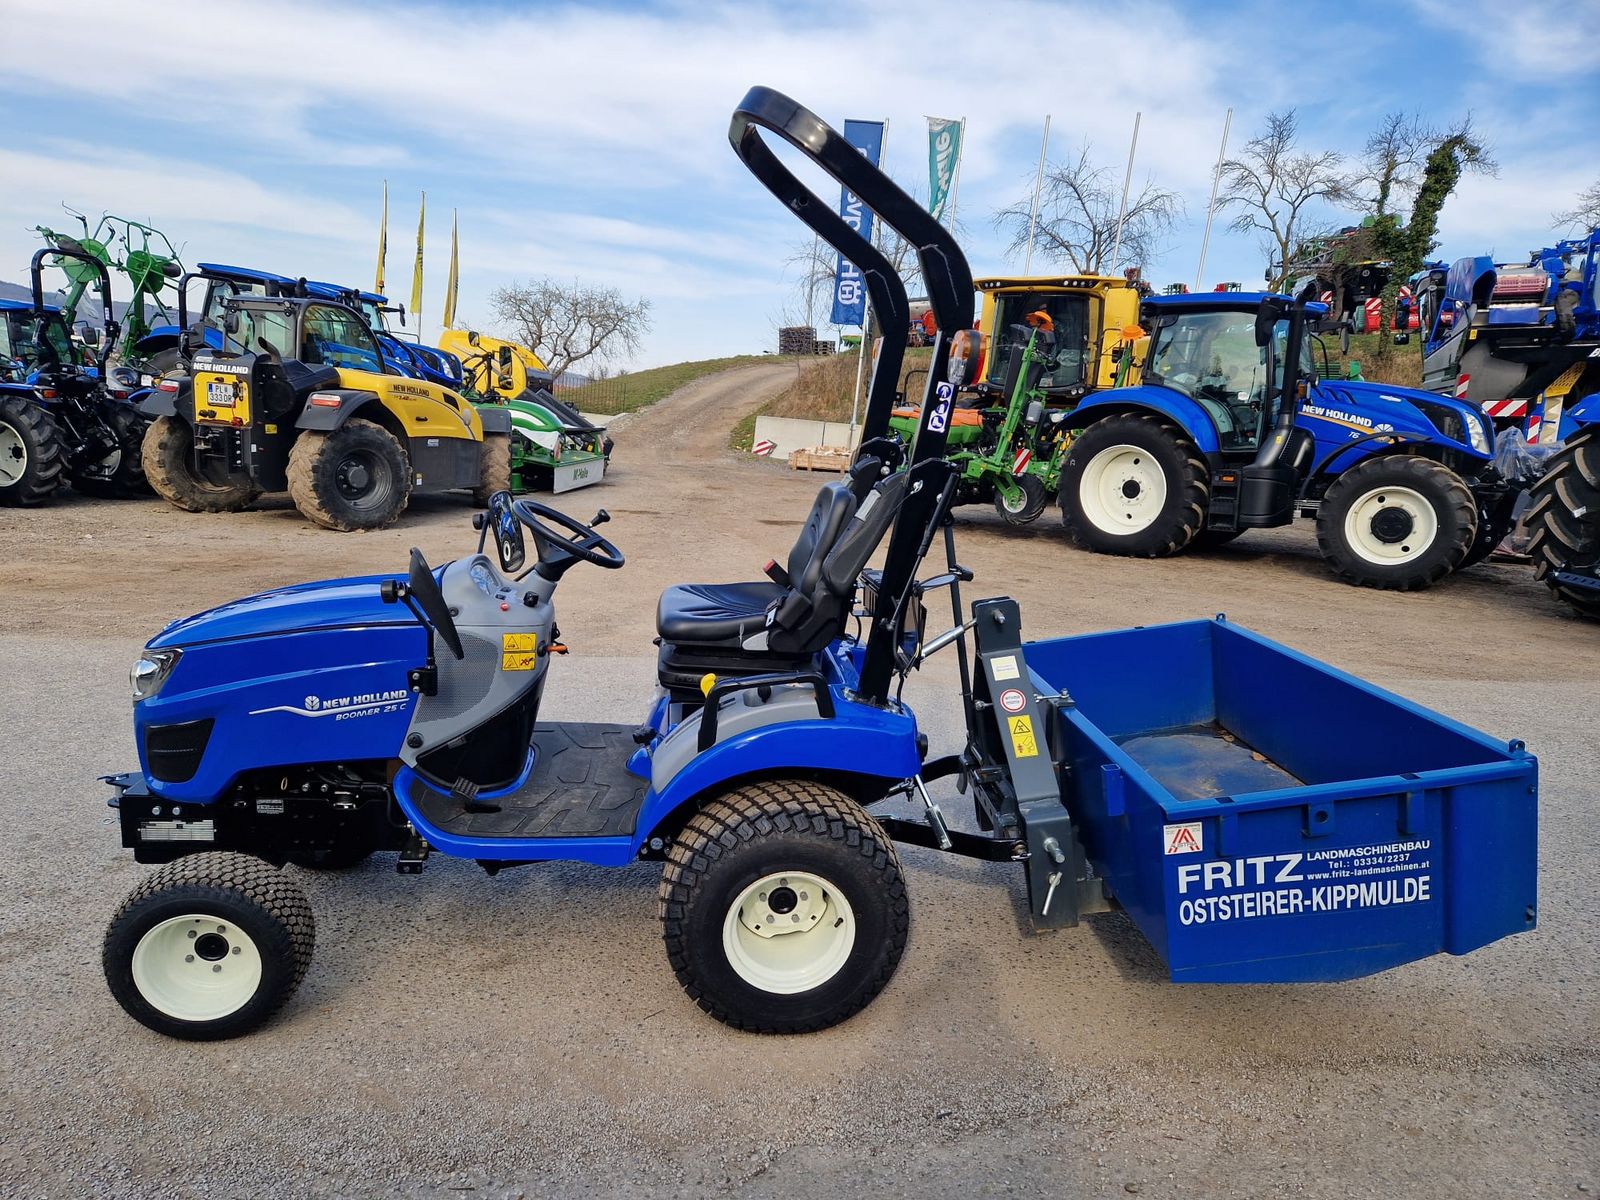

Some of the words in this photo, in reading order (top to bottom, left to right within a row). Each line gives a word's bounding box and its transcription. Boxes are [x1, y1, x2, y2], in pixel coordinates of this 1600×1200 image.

[193, 362, 212, 371] NEW
[212, 364, 249, 374] HOLLAND
[393, 384, 406, 392] NEW
[406, 385, 429, 397] HOLLAND
[1302, 404, 1325, 415] NEW
[1325, 408, 1372, 427] HOLLAND
[1348, 431, 1360, 439] T6
[322, 697, 350, 709] NEW
[353, 689, 408, 704] HOLLAND
[335, 707, 380, 721] BOOMER
[383, 704, 398, 713] 25
[1306, 839, 1431, 861] LANDMASCHINENBAU
[1307, 860, 1430, 880] www.fritz-landmaschinen.at
[1328, 860, 1351, 869] Tel.:
[1353, 853, 1411, 867] 03334/2237
[1177, 853, 1304, 894] FRITZ
[1179, 875, 1431, 926] OSTSTEIRER-KIPPMULDE
